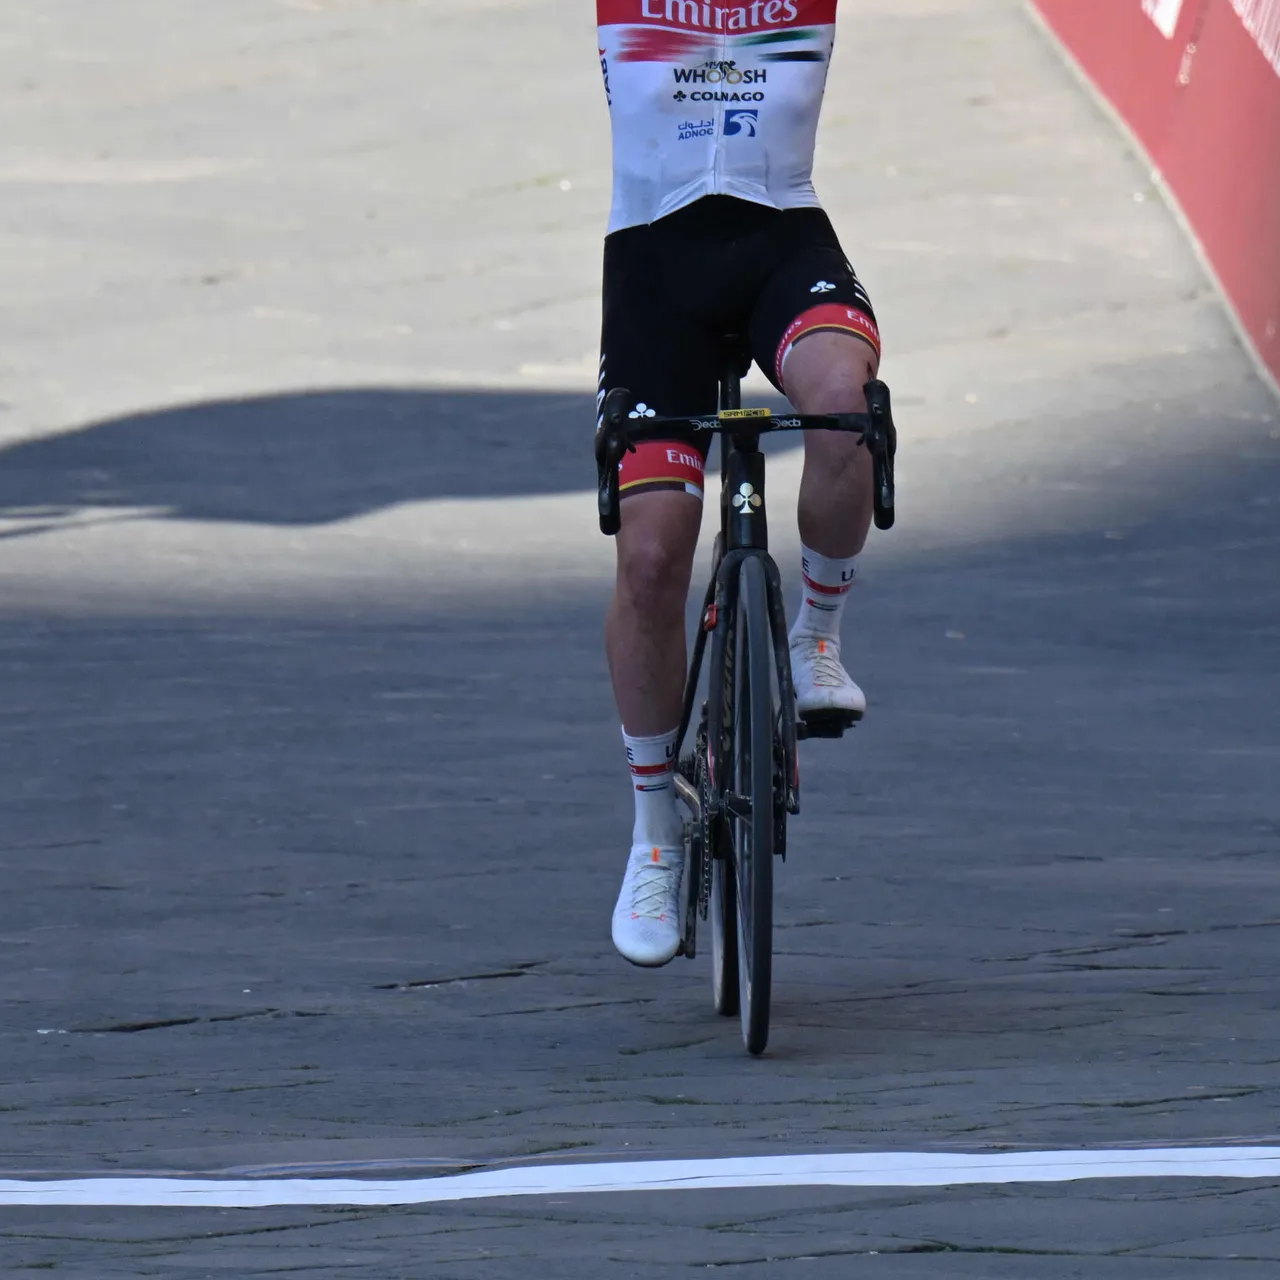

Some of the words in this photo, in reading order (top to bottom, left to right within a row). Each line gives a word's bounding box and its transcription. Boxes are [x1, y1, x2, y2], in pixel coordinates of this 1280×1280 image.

[673, 68, 767, 85] WHOOSH
[690, 90, 765, 102] COLNAGO
[677, 127, 715, 140] ADNOC
